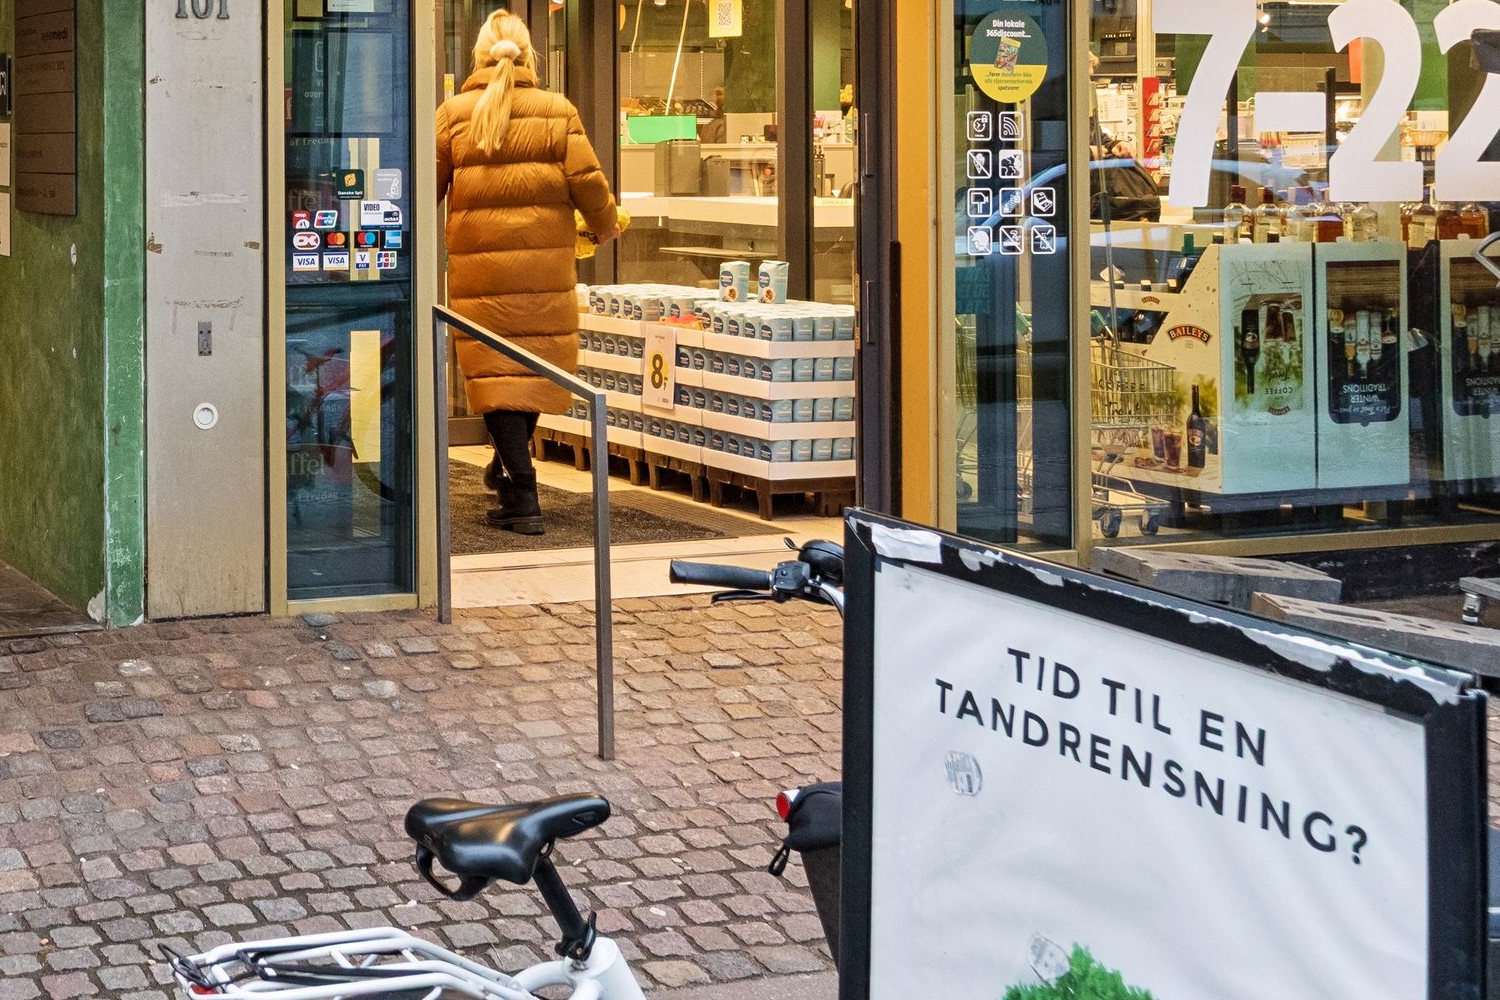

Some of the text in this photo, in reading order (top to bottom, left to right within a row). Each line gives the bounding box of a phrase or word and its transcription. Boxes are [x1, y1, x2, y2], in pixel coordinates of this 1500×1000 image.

[992, 19, 1025, 29] Din lokale
[363, 203, 381, 212] VIDEO
[296, 257, 316, 266] VISA
[327, 256, 346, 265] VISA
[1169, 326, 1210, 342] BAILEYS
[1264, 386, 1294, 395] COFFEE
[1342, 383, 1387, 394] TRADITIONS
[1007, 647, 1267, 768] TID TIL EN
[935, 678, 1370, 866] TANDRENSNING?
